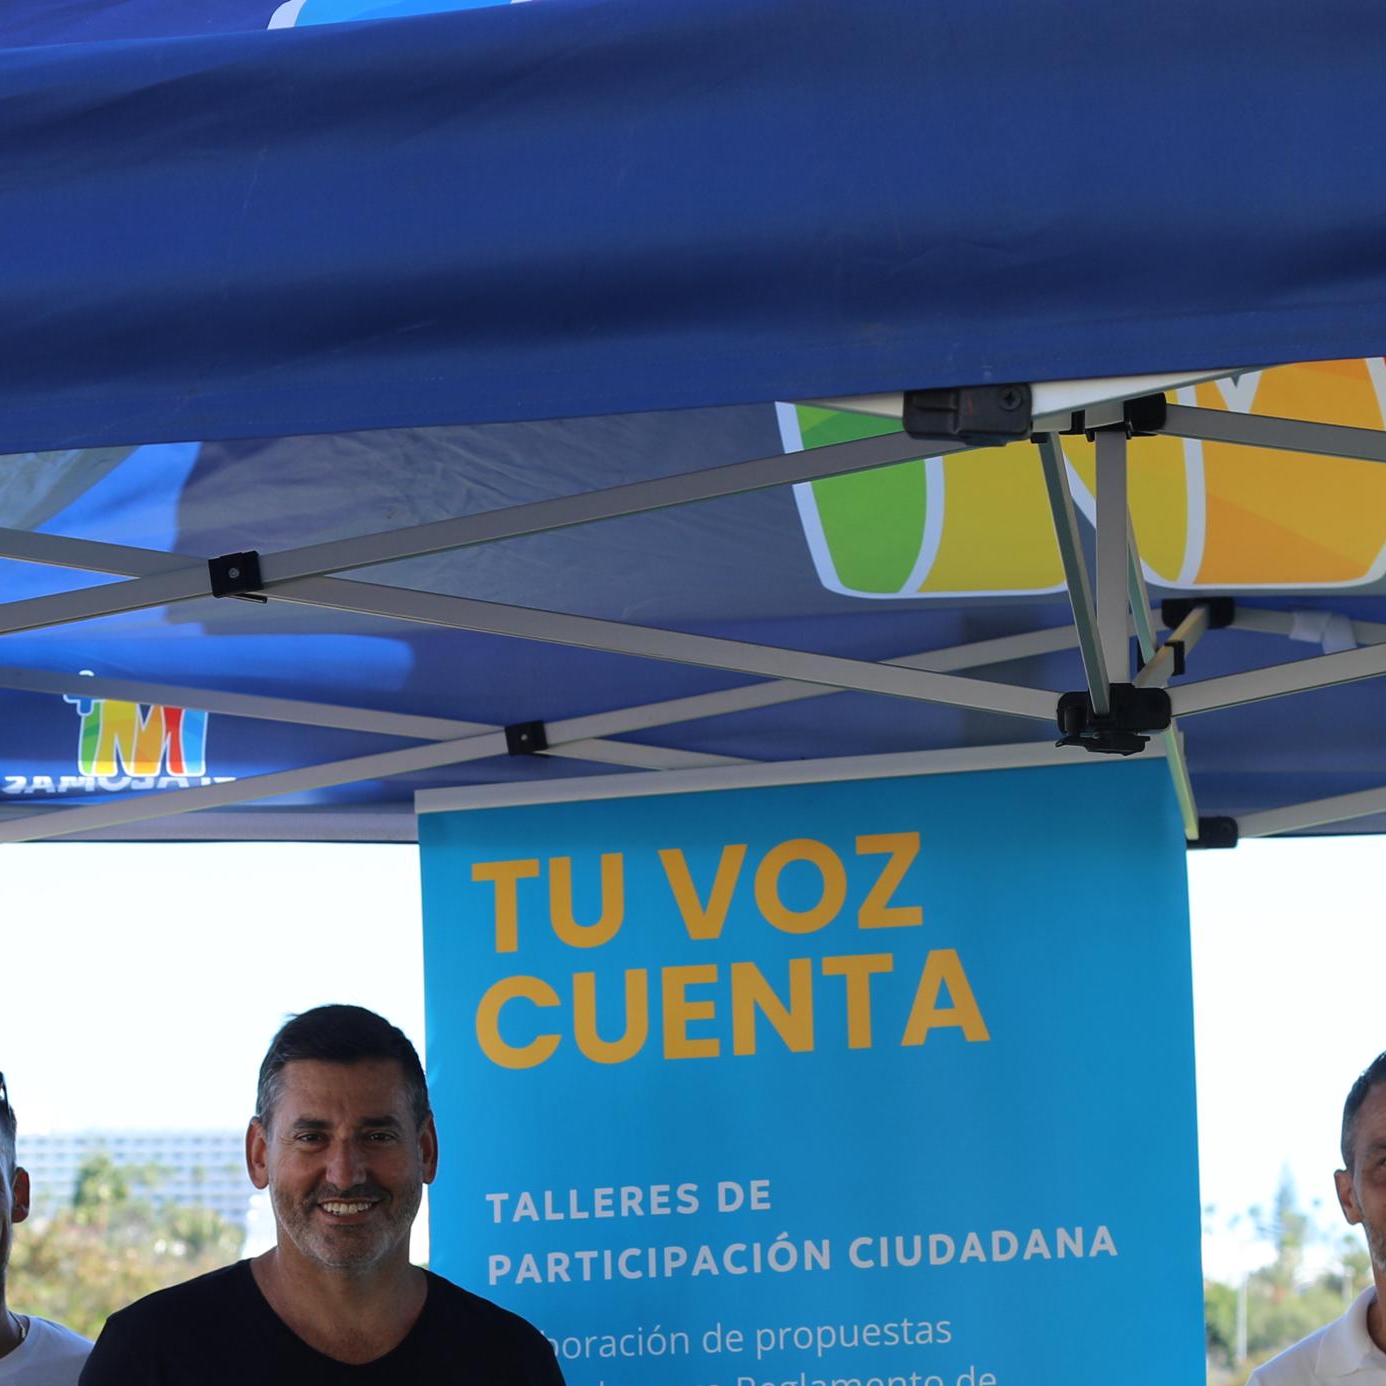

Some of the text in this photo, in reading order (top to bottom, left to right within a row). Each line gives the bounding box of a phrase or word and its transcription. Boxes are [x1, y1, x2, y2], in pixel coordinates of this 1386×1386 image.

[471, 831, 924, 954] TU VOZ
[475, 948, 992, 1070] CUENTA
[485, 1179, 773, 1225] TALLERES DE
[488, 1226, 1119, 1287] PARTICIPACIÓN CIUDADANA
[701, 1318, 745, 1353] de
[755, 1317, 953, 1360] propuestas
